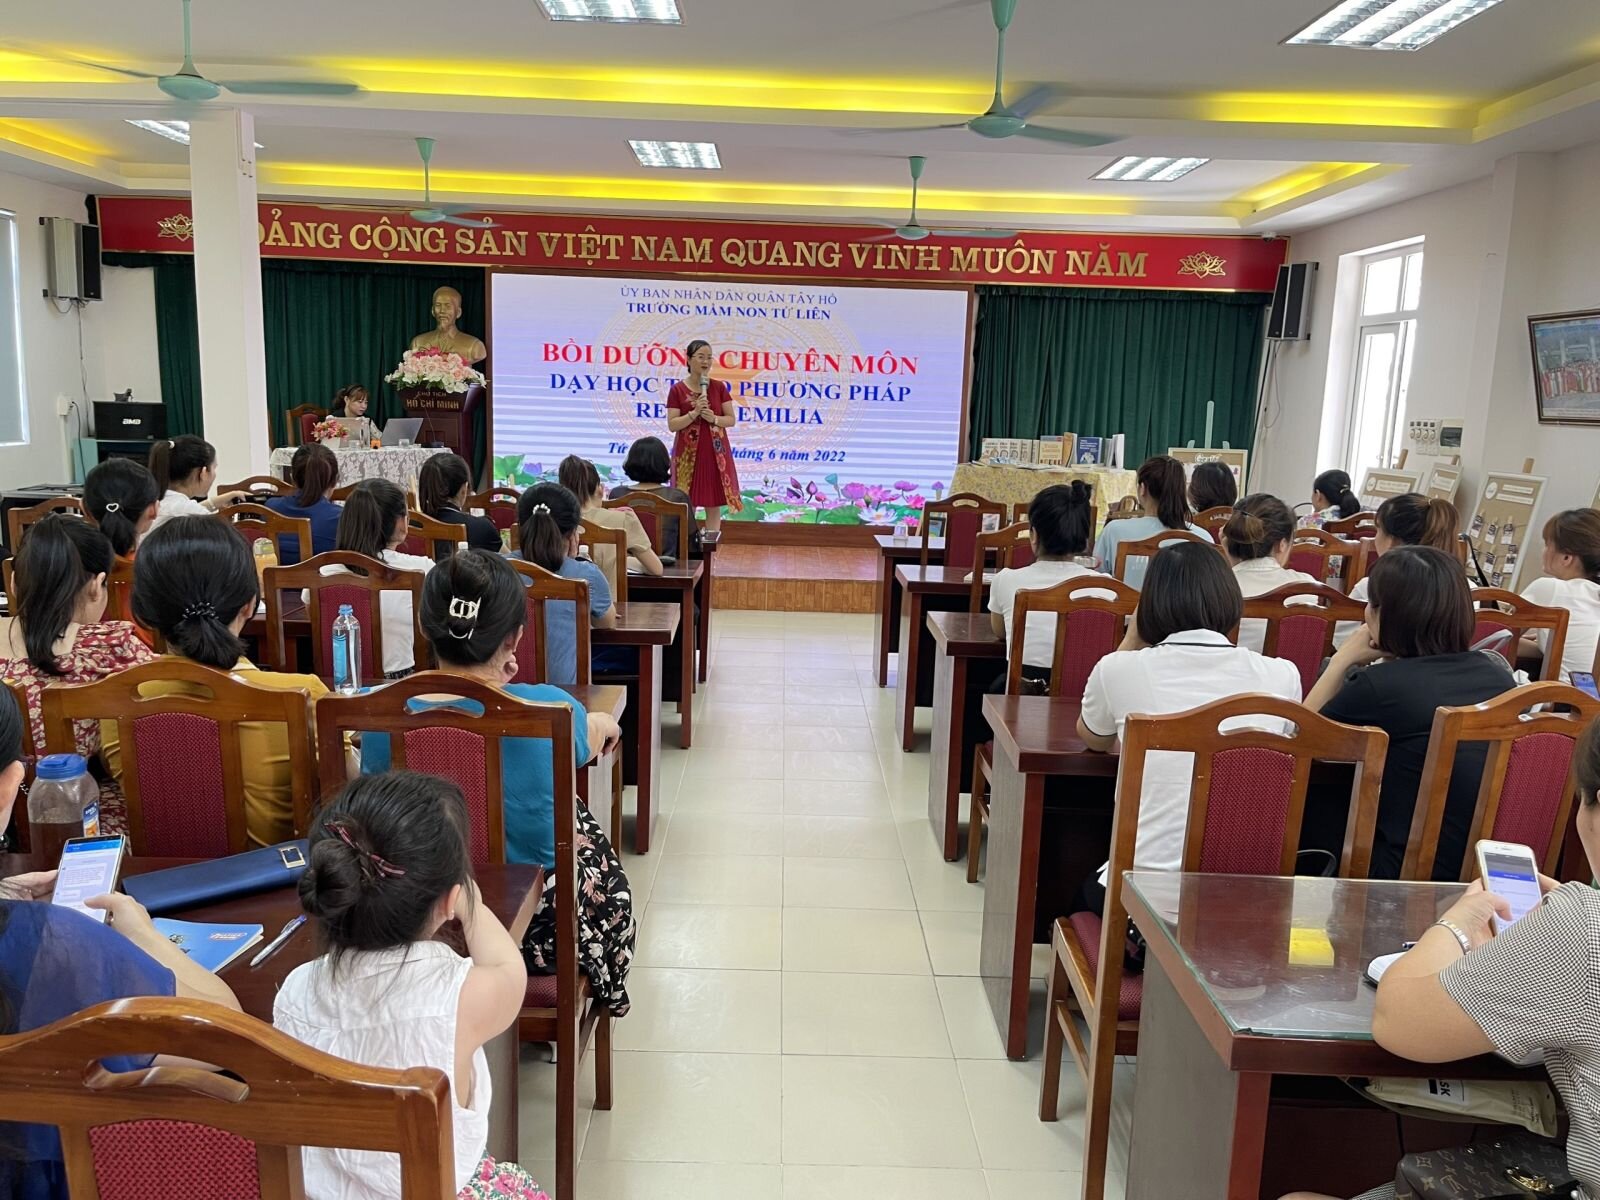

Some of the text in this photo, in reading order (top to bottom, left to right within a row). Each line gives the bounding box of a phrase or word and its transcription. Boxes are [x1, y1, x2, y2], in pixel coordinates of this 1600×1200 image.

[258, 208, 1149, 278] ẢNG CỘNG SẢN VIỆT NAM QUANG VINH MUÔN NĂM
[643, 288, 671, 299] BAN
[674, 287, 712, 300] NHÂN
[715, 289, 744, 301] DÂN
[788, 291, 816, 304] TÂY
[626, 301, 691, 315] TRƯỜNG
[735, 306, 767, 318] NON
[796, 306, 831, 320] LIÊN
[543, 338, 920, 376] BỒI DƯỠN CHUYÊN MÔN
[550, 373, 600, 394] DẠY
[607, 375, 659, 396] HỌC
[739, 380, 842, 401] PHƯƠNG
[849, 381, 912, 402] PHÁP
[737, 406, 824, 425] EMILIA
[730, 446, 846, 462] háng 6 năm 2022
